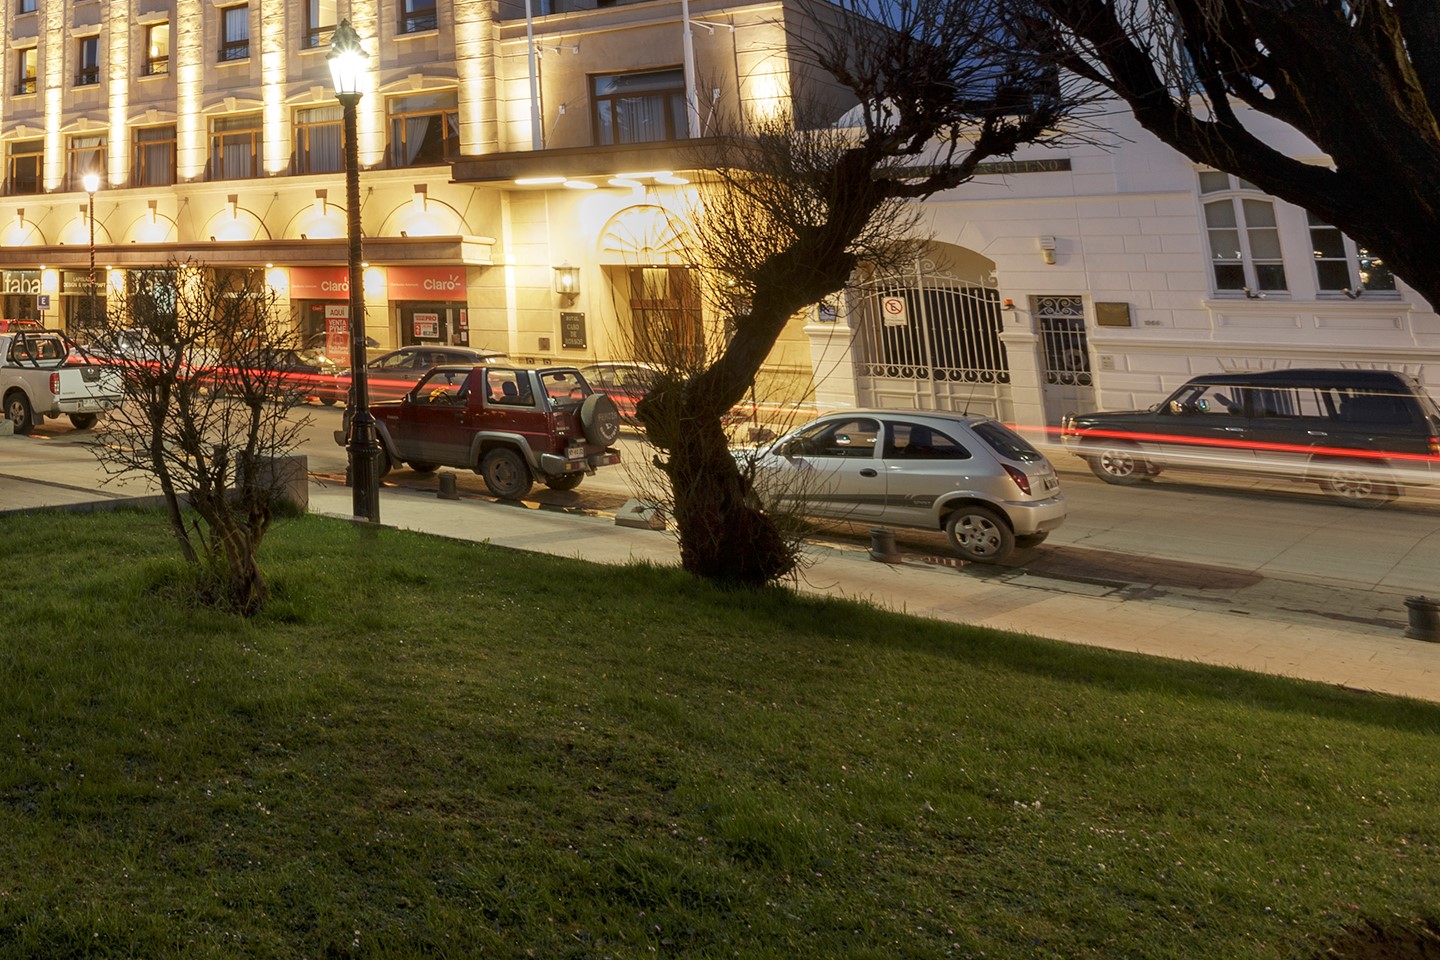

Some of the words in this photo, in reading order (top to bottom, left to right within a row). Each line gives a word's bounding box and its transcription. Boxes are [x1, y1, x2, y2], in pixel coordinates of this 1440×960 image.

[5, 273, 41, 294] faba
[321, 280, 349, 292] Claro
[423, 279, 455, 290] Claro
[41, 296, 47, 305] E
[329, 325, 347, 333] PYME
